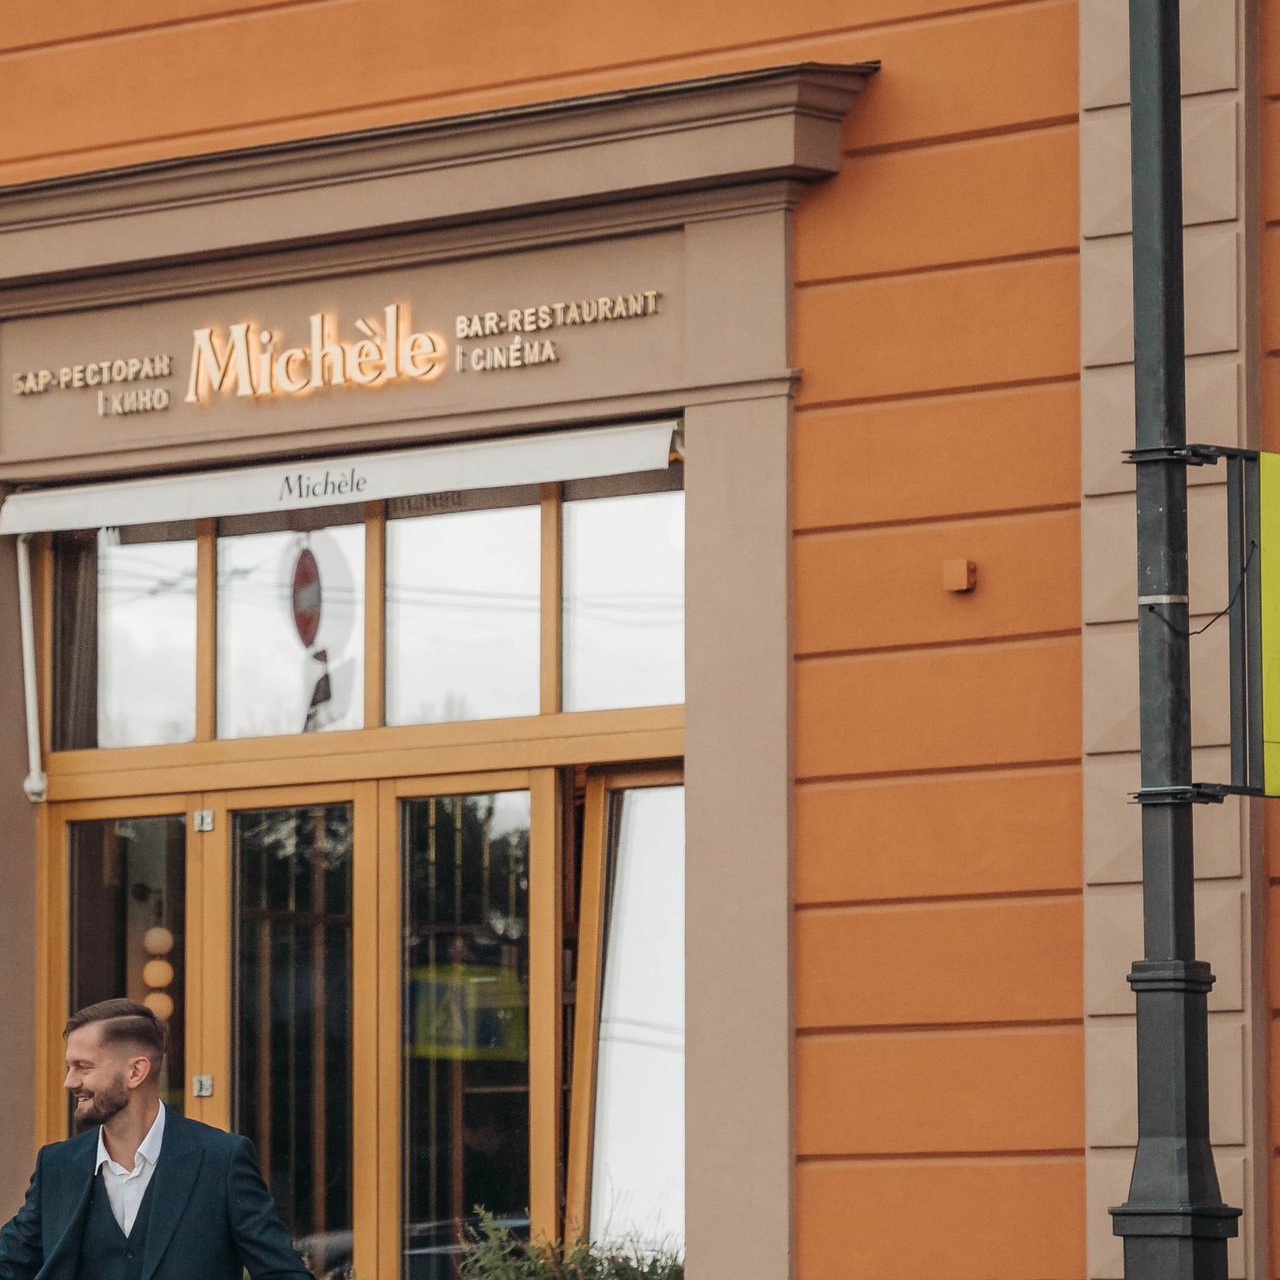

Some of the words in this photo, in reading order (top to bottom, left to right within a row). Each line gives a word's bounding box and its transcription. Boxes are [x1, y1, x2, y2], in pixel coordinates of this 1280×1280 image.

[455, 290, 658, 338] BAR-RESTAURANT
[184, 303, 438, 404] Michèle
[471, 335, 557, 371] CINÉMA
[12, 354, 171, 395] БАР-РЕСТОРАН
[111, 387, 170, 415] КИНО
[279, 468, 368, 501] Michèle
